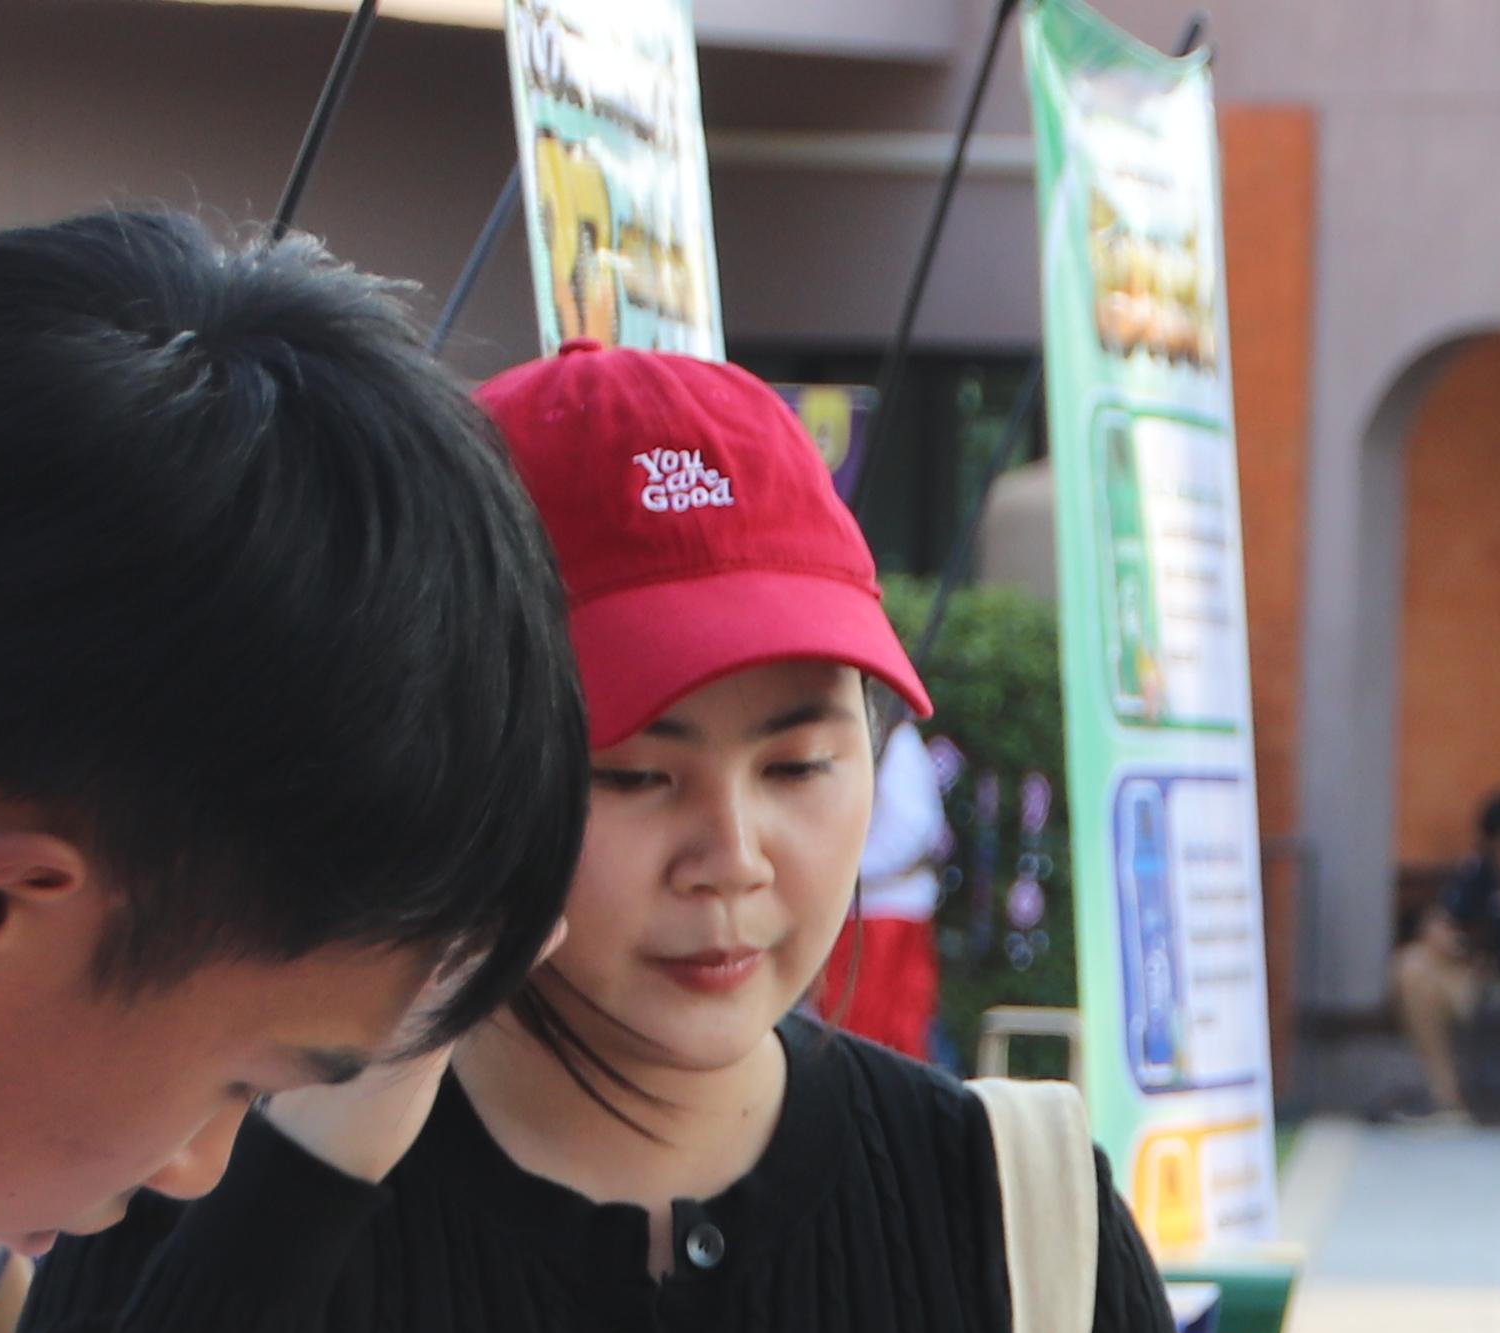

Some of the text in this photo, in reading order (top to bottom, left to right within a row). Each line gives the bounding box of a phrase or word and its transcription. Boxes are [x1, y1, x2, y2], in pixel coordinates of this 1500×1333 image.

[632, 447, 704, 483] You
[666, 467, 720, 493] are
[641, 477, 735, 513] Good
